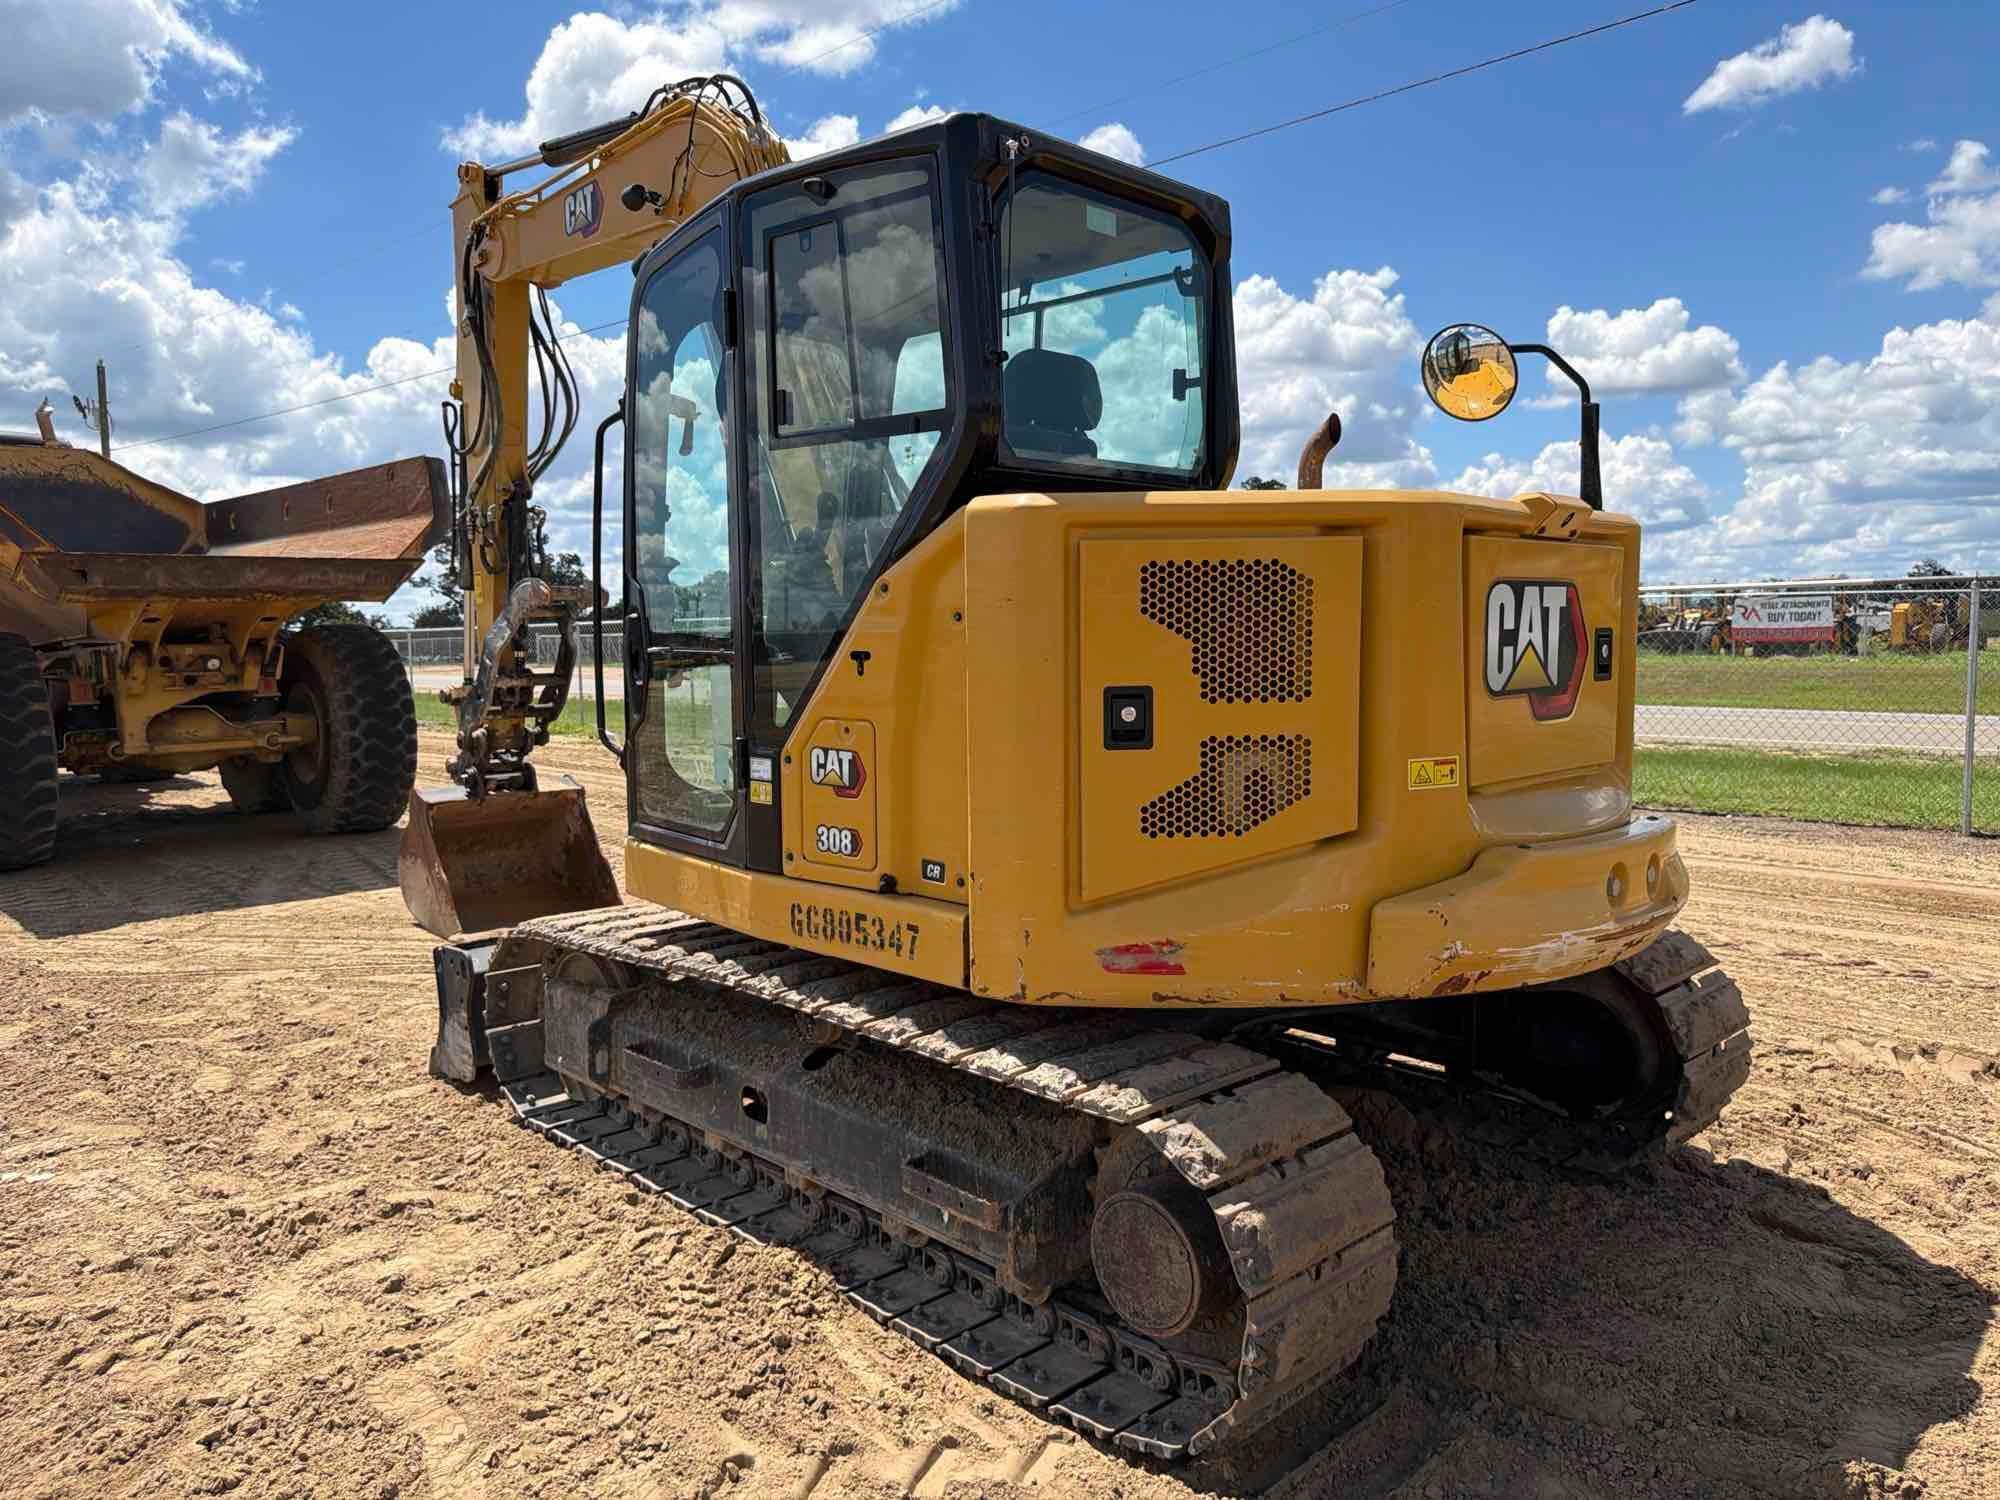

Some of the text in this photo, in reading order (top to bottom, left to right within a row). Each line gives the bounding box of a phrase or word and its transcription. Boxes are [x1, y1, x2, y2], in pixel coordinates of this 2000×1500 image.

[565, 184, 593, 234] CAT
[1767, 611, 1821, 623] BUY TODAY!
[1487, 583, 1567, 691] CAT
[811, 747, 852, 786] CAT
[816, 826, 852, 855] 308
[926, 863, 941, 879] CR
